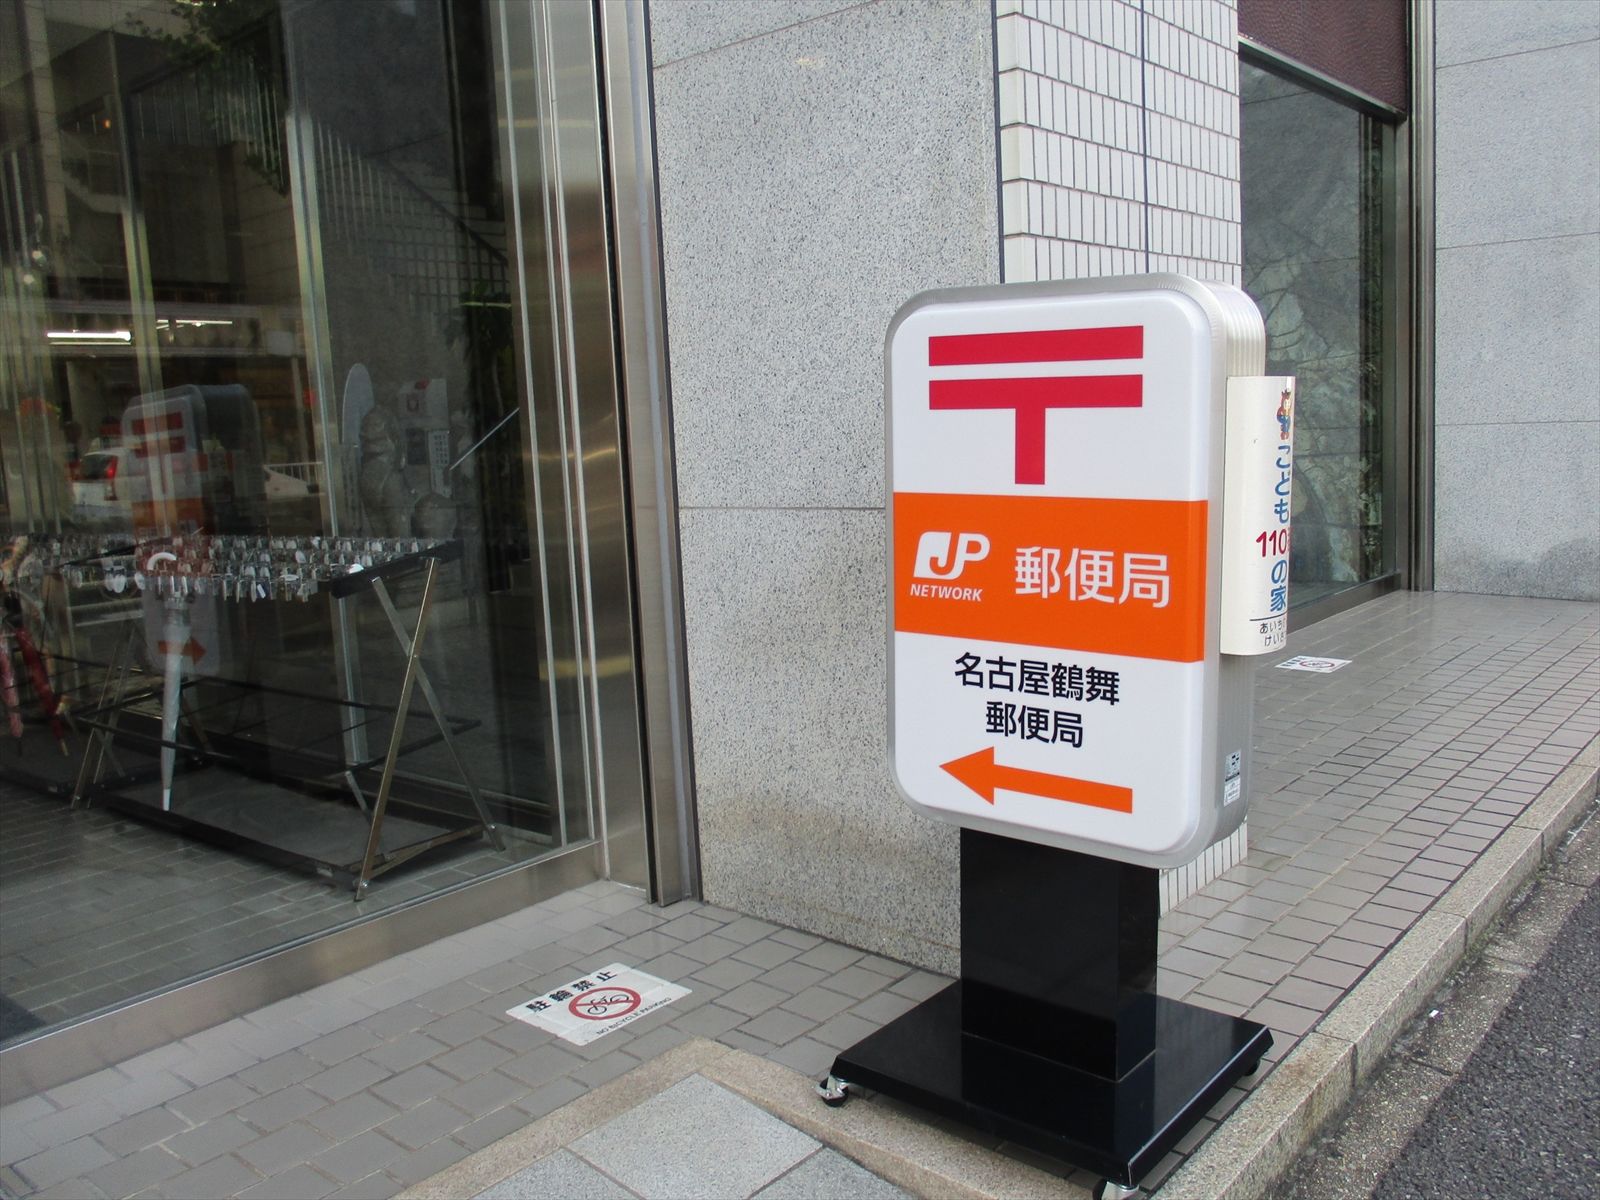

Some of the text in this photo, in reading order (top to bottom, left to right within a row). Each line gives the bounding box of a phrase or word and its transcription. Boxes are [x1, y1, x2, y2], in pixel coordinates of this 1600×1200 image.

[1256, 445, 1293, 613] こども110の家
[913, 531, 991, 580] JP
[1015, 546, 1170, 608] 郵便局
[910, 583, 982, 602] NETWORK
[954, 651, 1120, 706] 名古屋鶴舞
[986, 701, 1083, 748] 郵便局
